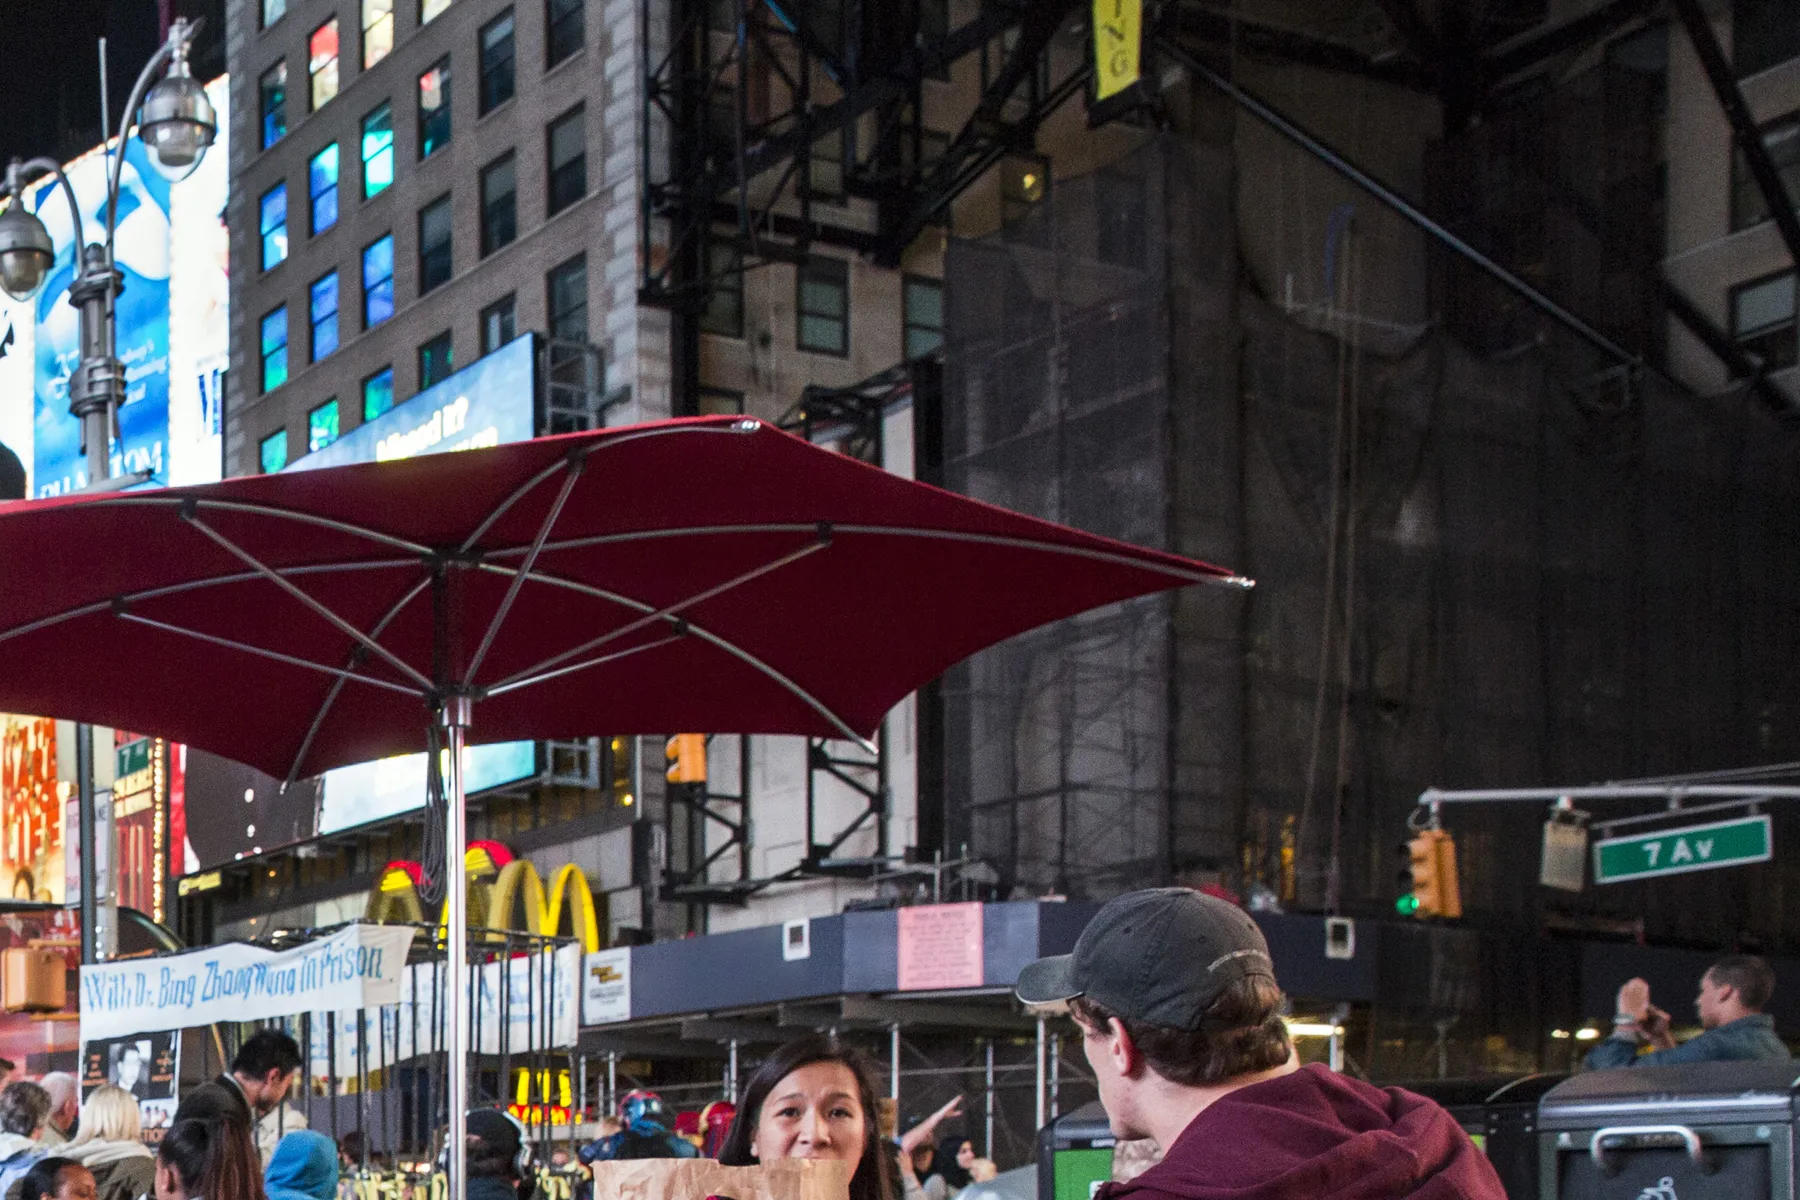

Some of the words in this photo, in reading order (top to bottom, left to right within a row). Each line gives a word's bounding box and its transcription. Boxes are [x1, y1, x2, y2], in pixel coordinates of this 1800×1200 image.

[1642, 841, 1662, 866] 7
[83, 970, 131, 1012] With
[157, 966, 196, 1010] Bing
